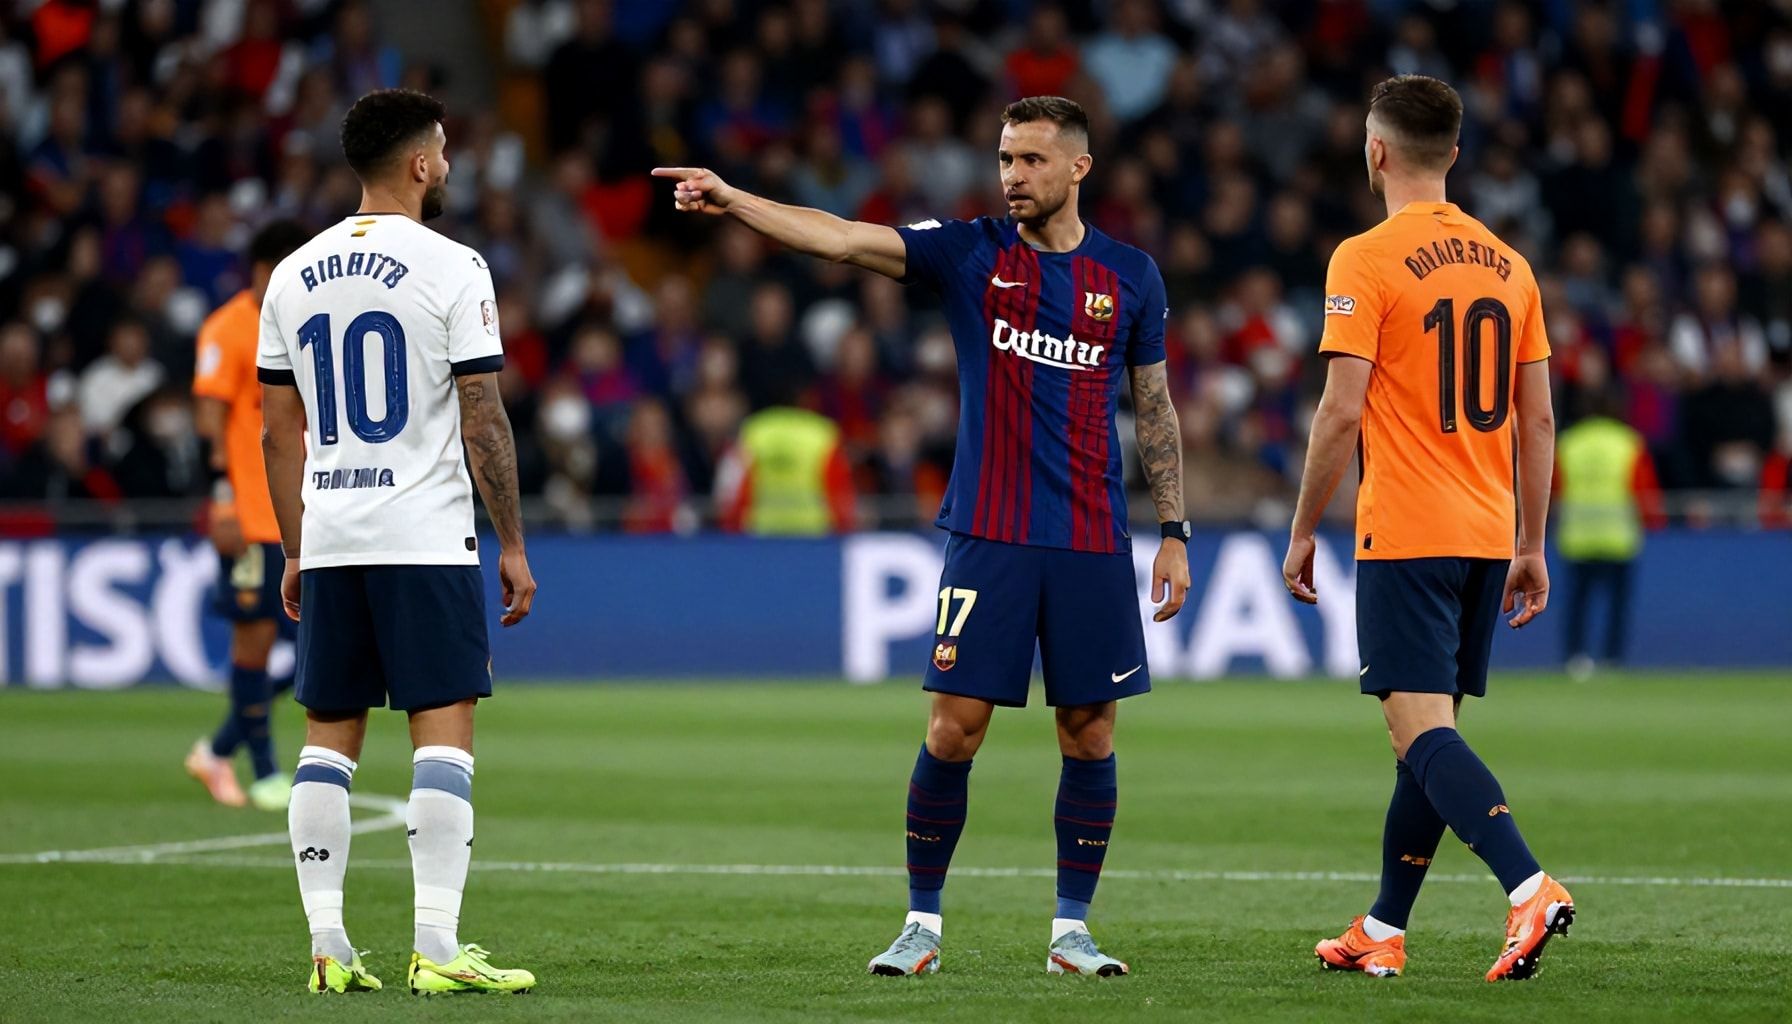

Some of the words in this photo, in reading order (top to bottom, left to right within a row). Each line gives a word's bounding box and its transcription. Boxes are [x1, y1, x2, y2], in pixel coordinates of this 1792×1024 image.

[297, 311, 410, 446] 10
[1424, 297, 1512, 434] 10
[936, 586, 978, 637] 17
